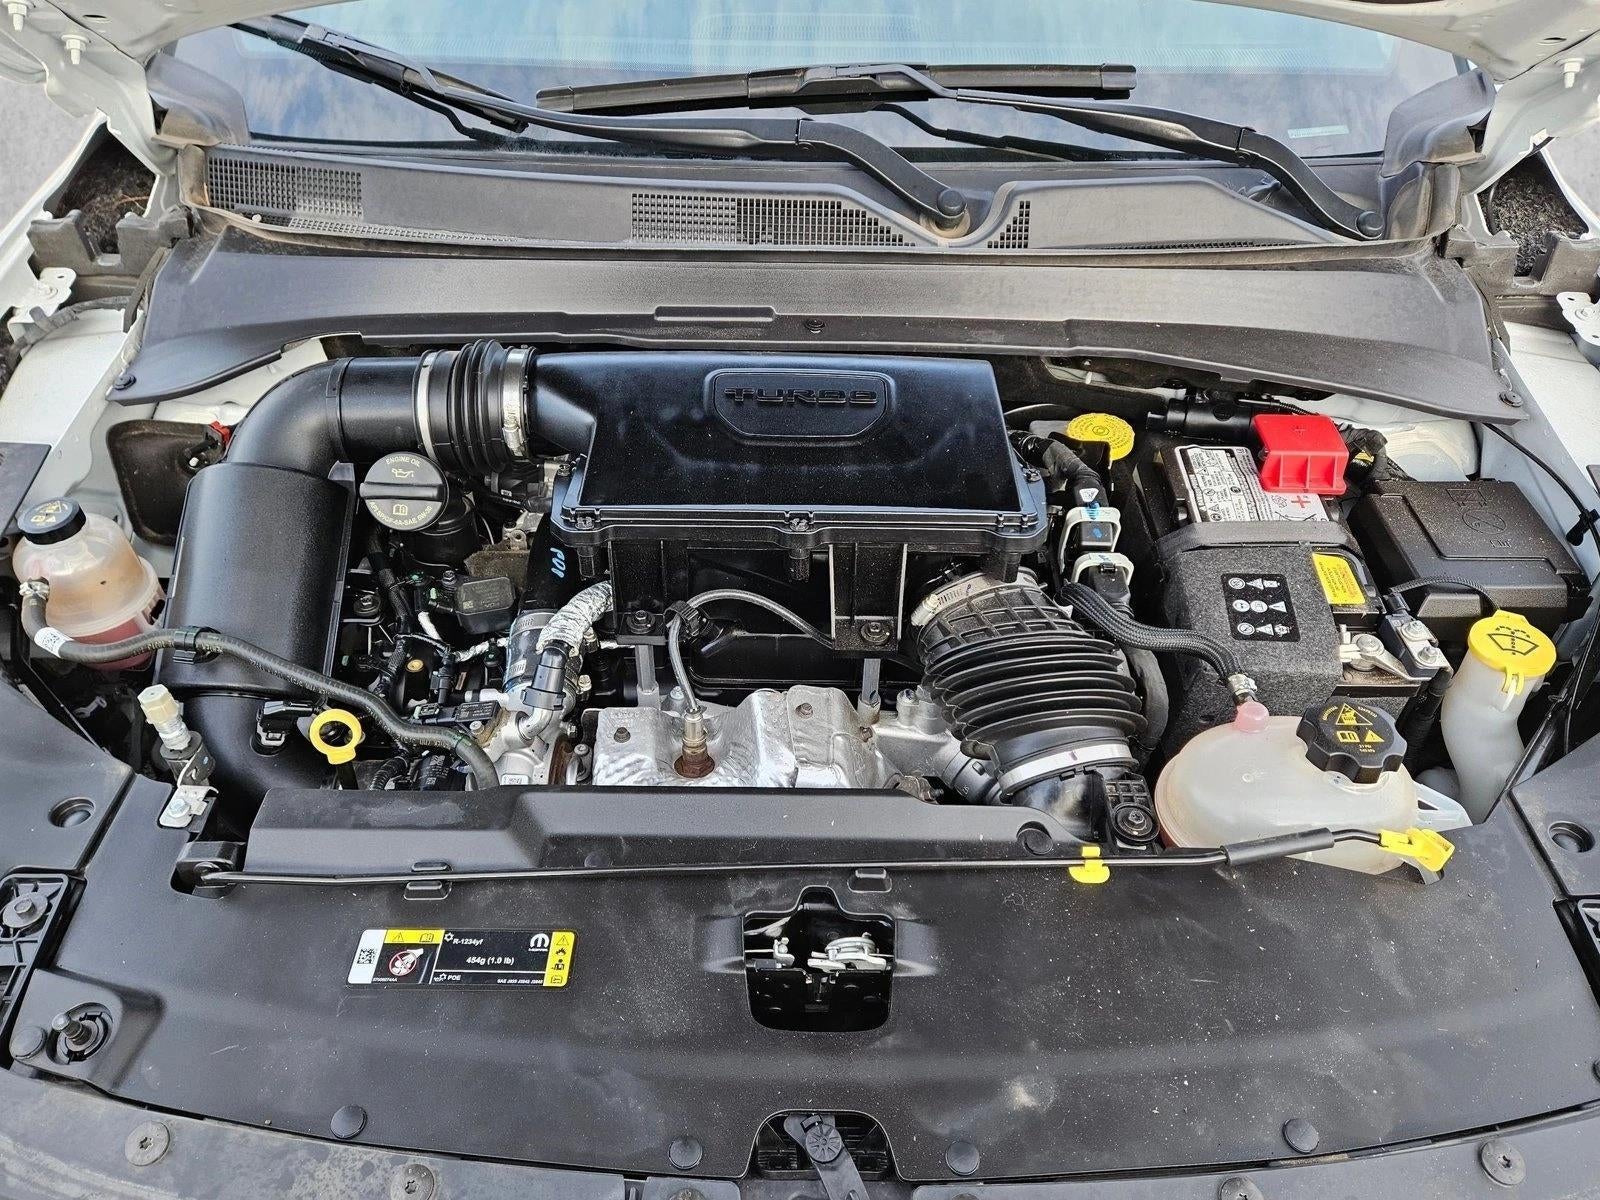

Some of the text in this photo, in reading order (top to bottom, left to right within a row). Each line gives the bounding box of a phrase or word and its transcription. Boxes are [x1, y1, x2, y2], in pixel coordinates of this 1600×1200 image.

[724, 387, 878, 405] TURBO
[385, 455, 422, 467] ENGINE OIL
[453, 938, 484, 947] R-1234yf
[466, 956, 515, 966] 454g (1.0 lb)
